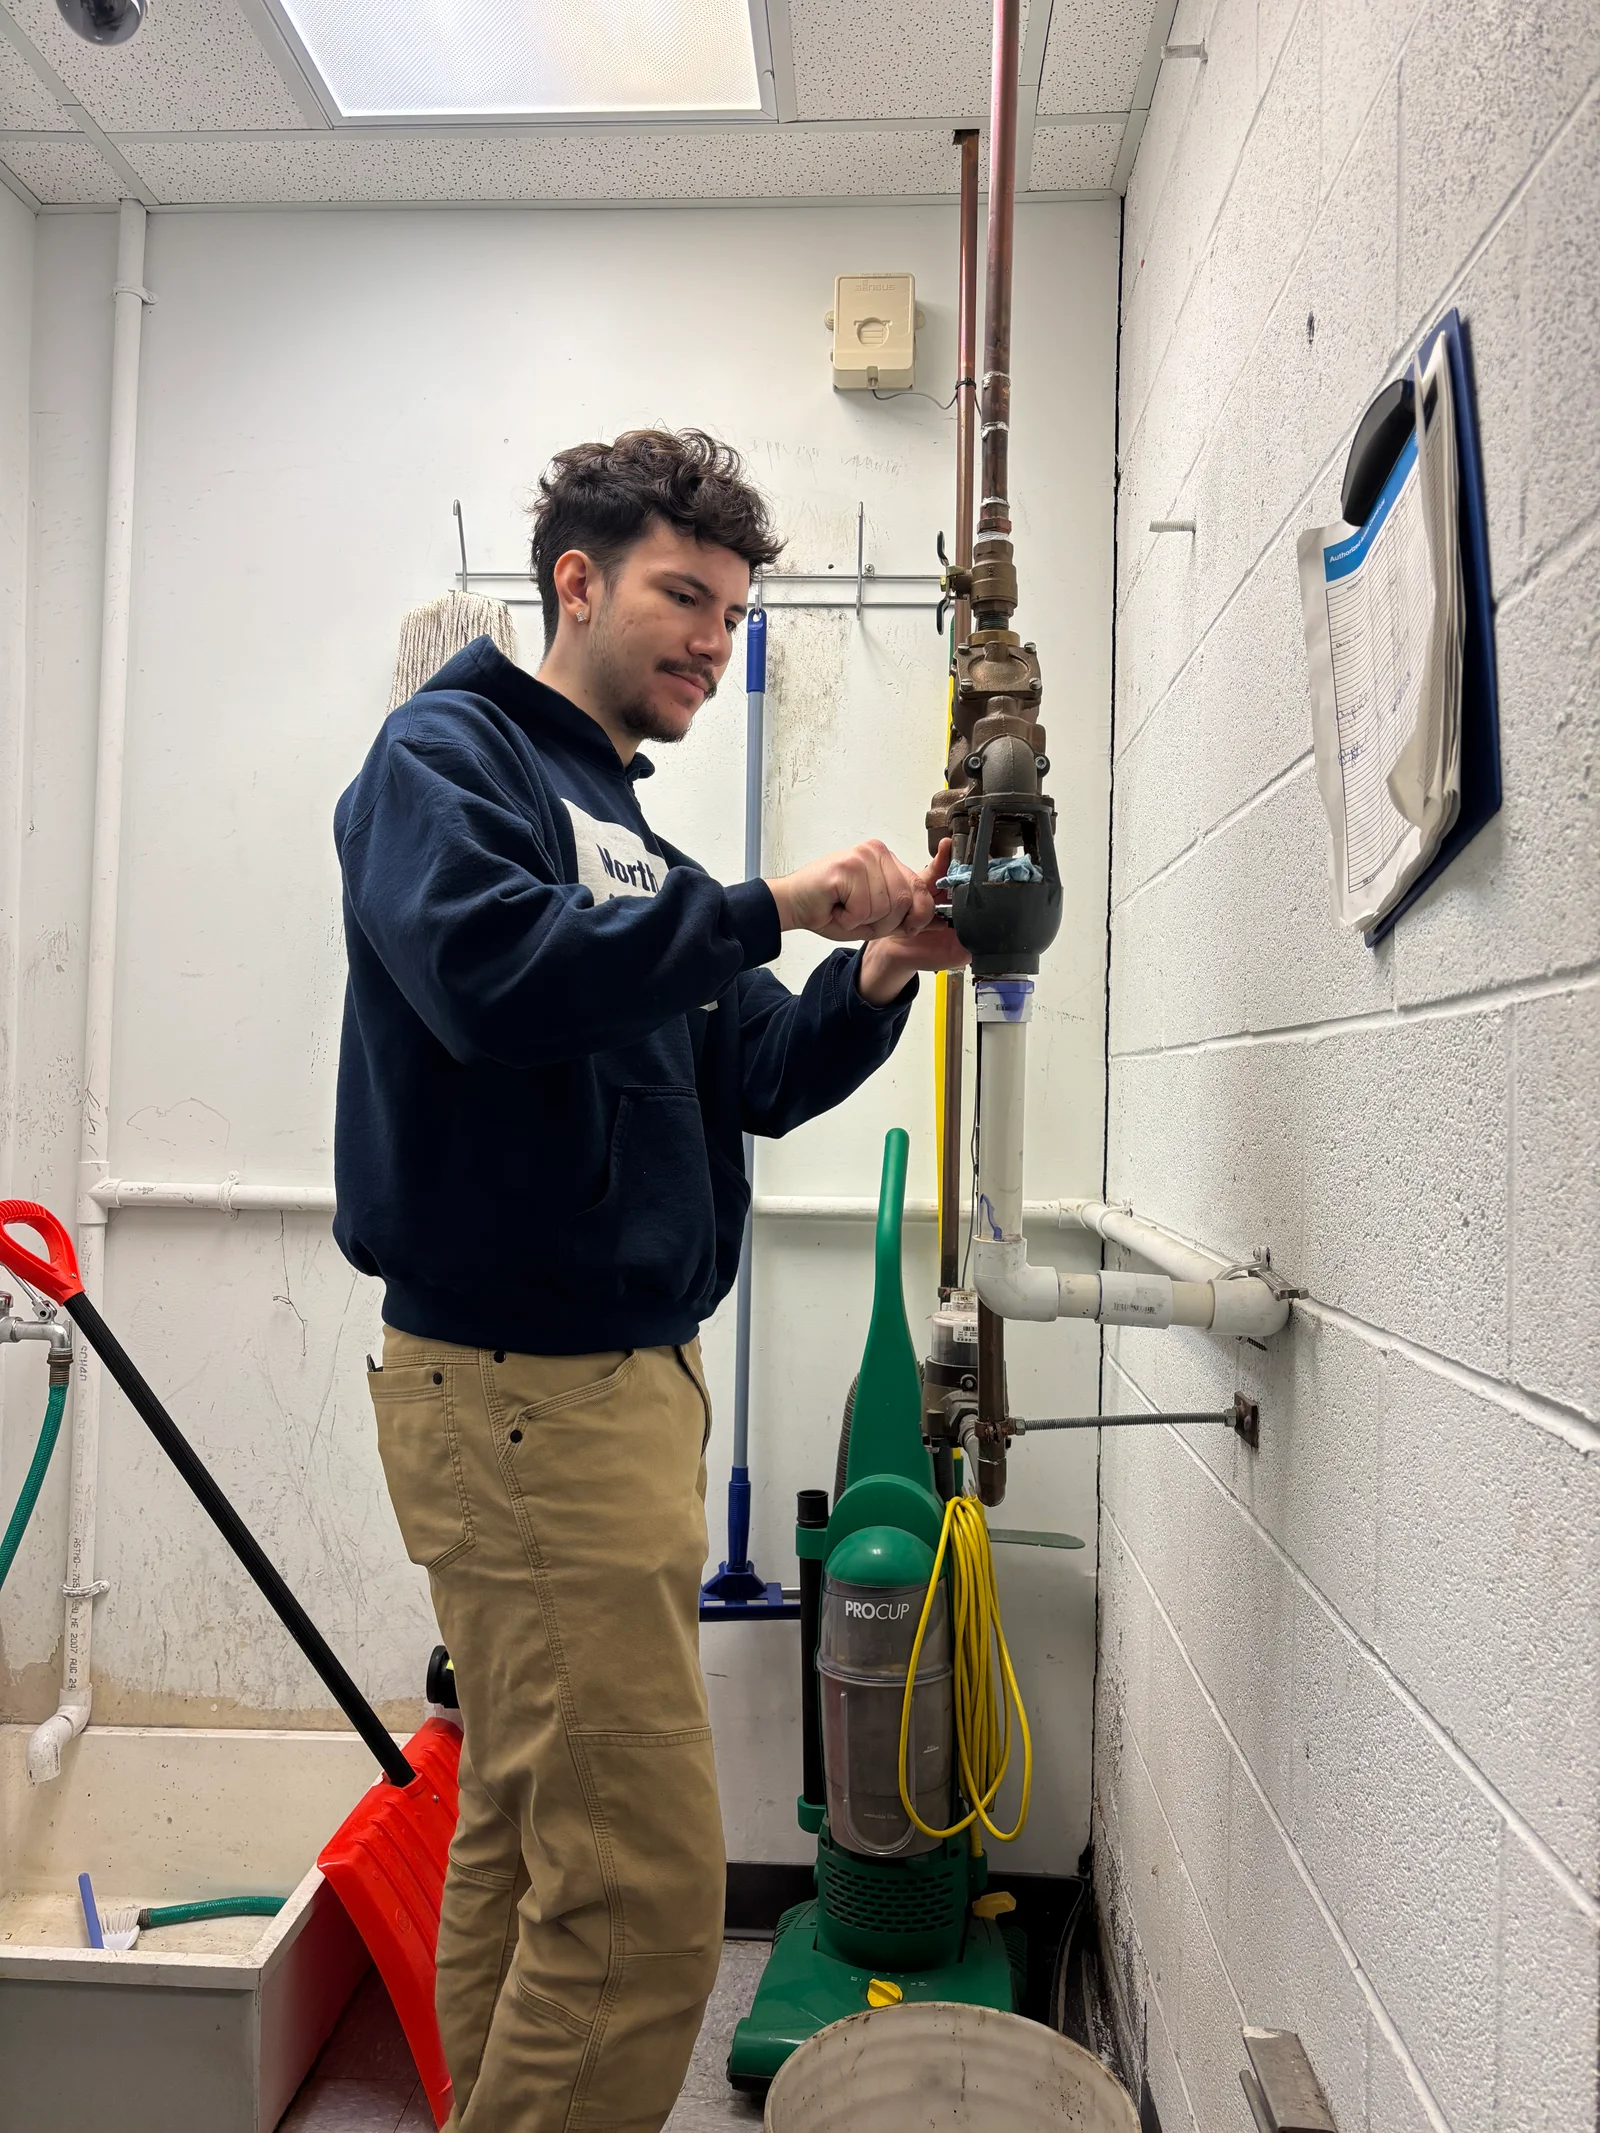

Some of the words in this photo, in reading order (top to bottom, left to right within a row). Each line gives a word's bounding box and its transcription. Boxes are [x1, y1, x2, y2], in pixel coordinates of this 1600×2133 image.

[1329, 540, 1361, 563] Authorized
[596, 843, 660, 894] North
[845, 1600, 910, 1620] PROCUP
[70, 1633, 79, 1654] 2007
[69, 1658, 78, 1674] AUG
